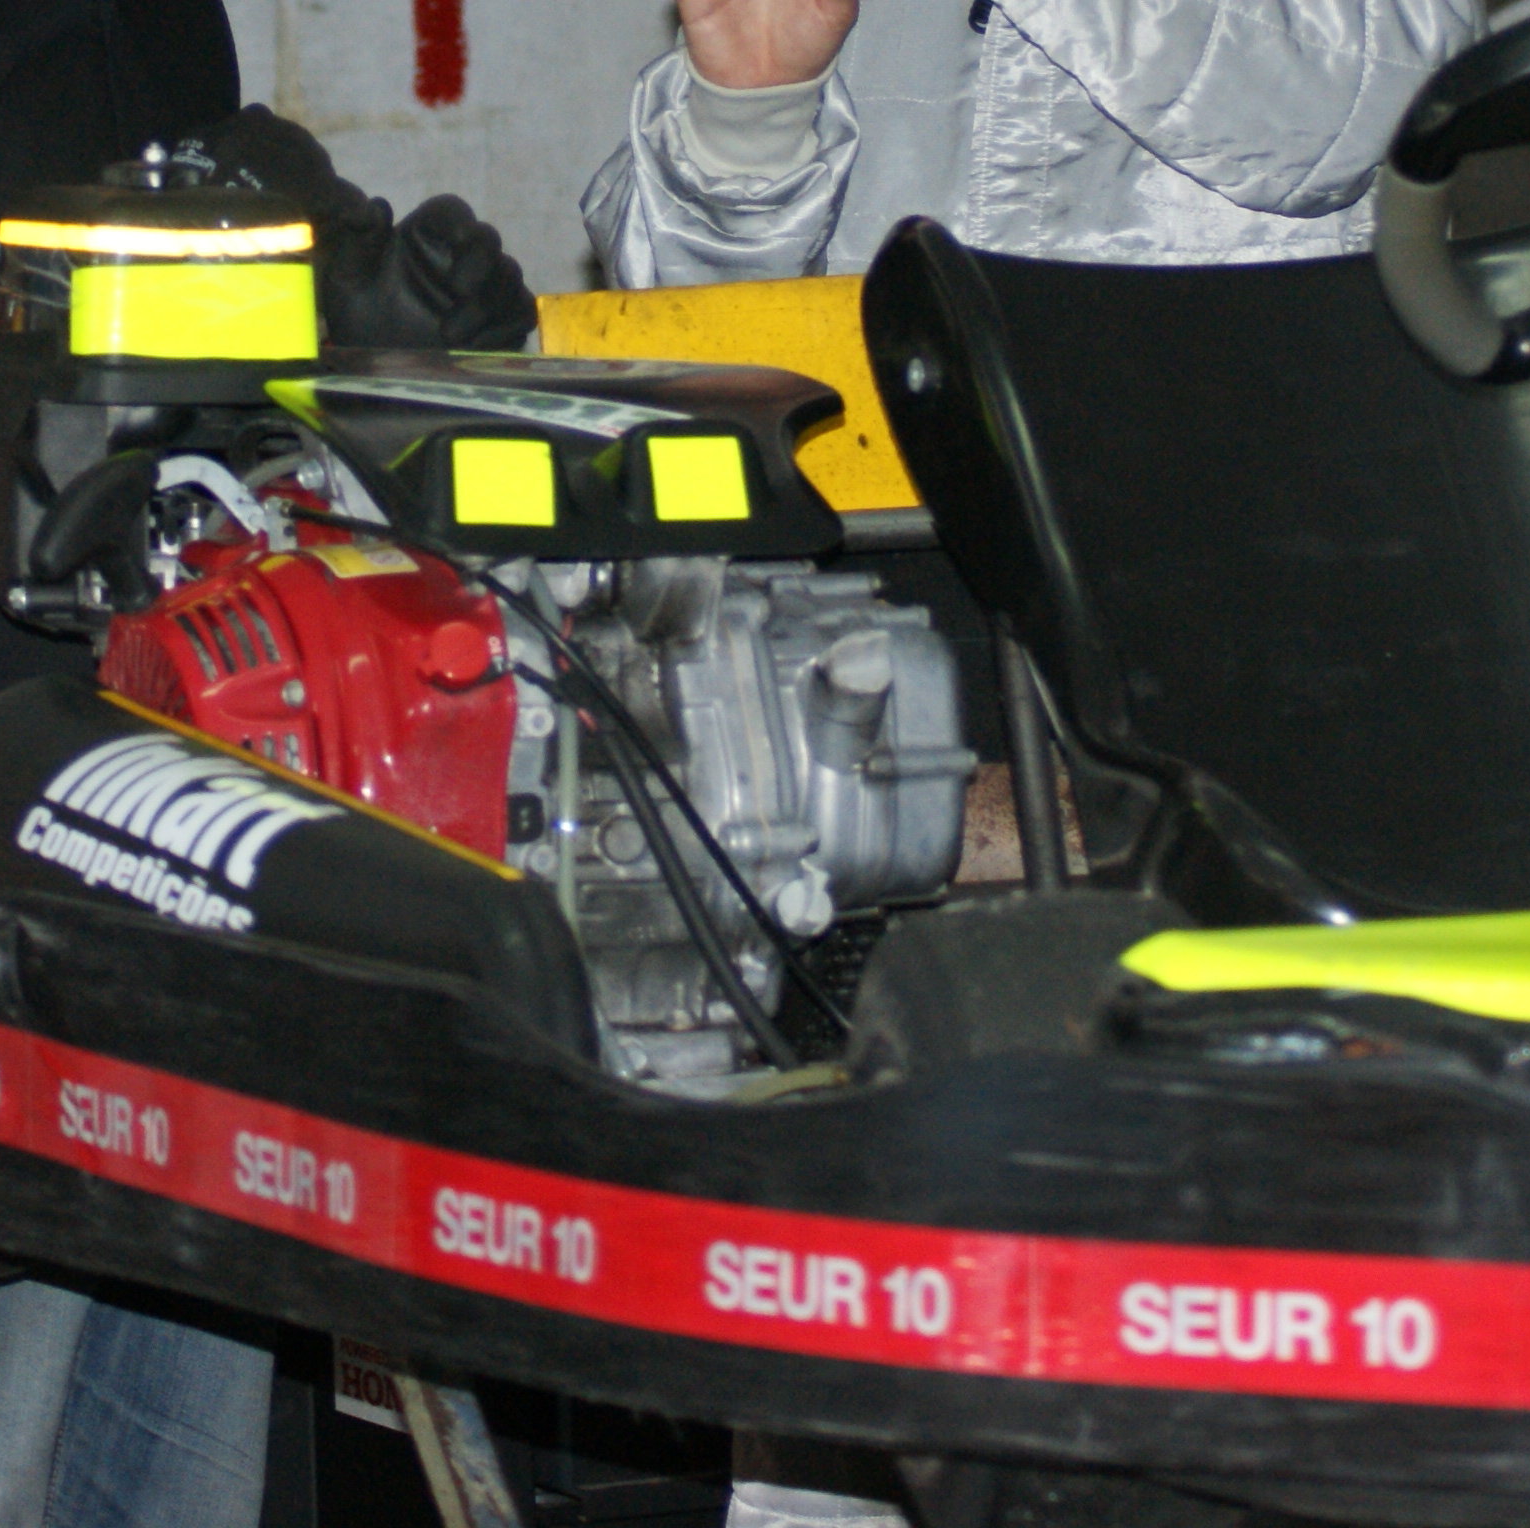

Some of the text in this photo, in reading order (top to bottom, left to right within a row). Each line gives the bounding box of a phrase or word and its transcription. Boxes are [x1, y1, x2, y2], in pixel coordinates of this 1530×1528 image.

[16, 805, 255, 933] Competições
[59, 1080, 135, 1157] SEUR
[140, 1104, 170, 1166] 10
[233, 1130, 318, 1212] SEUR
[322, 1159, 356, 1224] 10
[432, 1187, 544, 1274] SEUR
[552, 1216, 597, 1284] 10
[703, 1240, 868, 1330] SEUR
[881, 1265, 954, 1338] 10
[1117, 1281, 1334, 1366] SEUR
[1349, 1297, 1438, 1372] 10
[340, 1361, 405, 1413] HON
